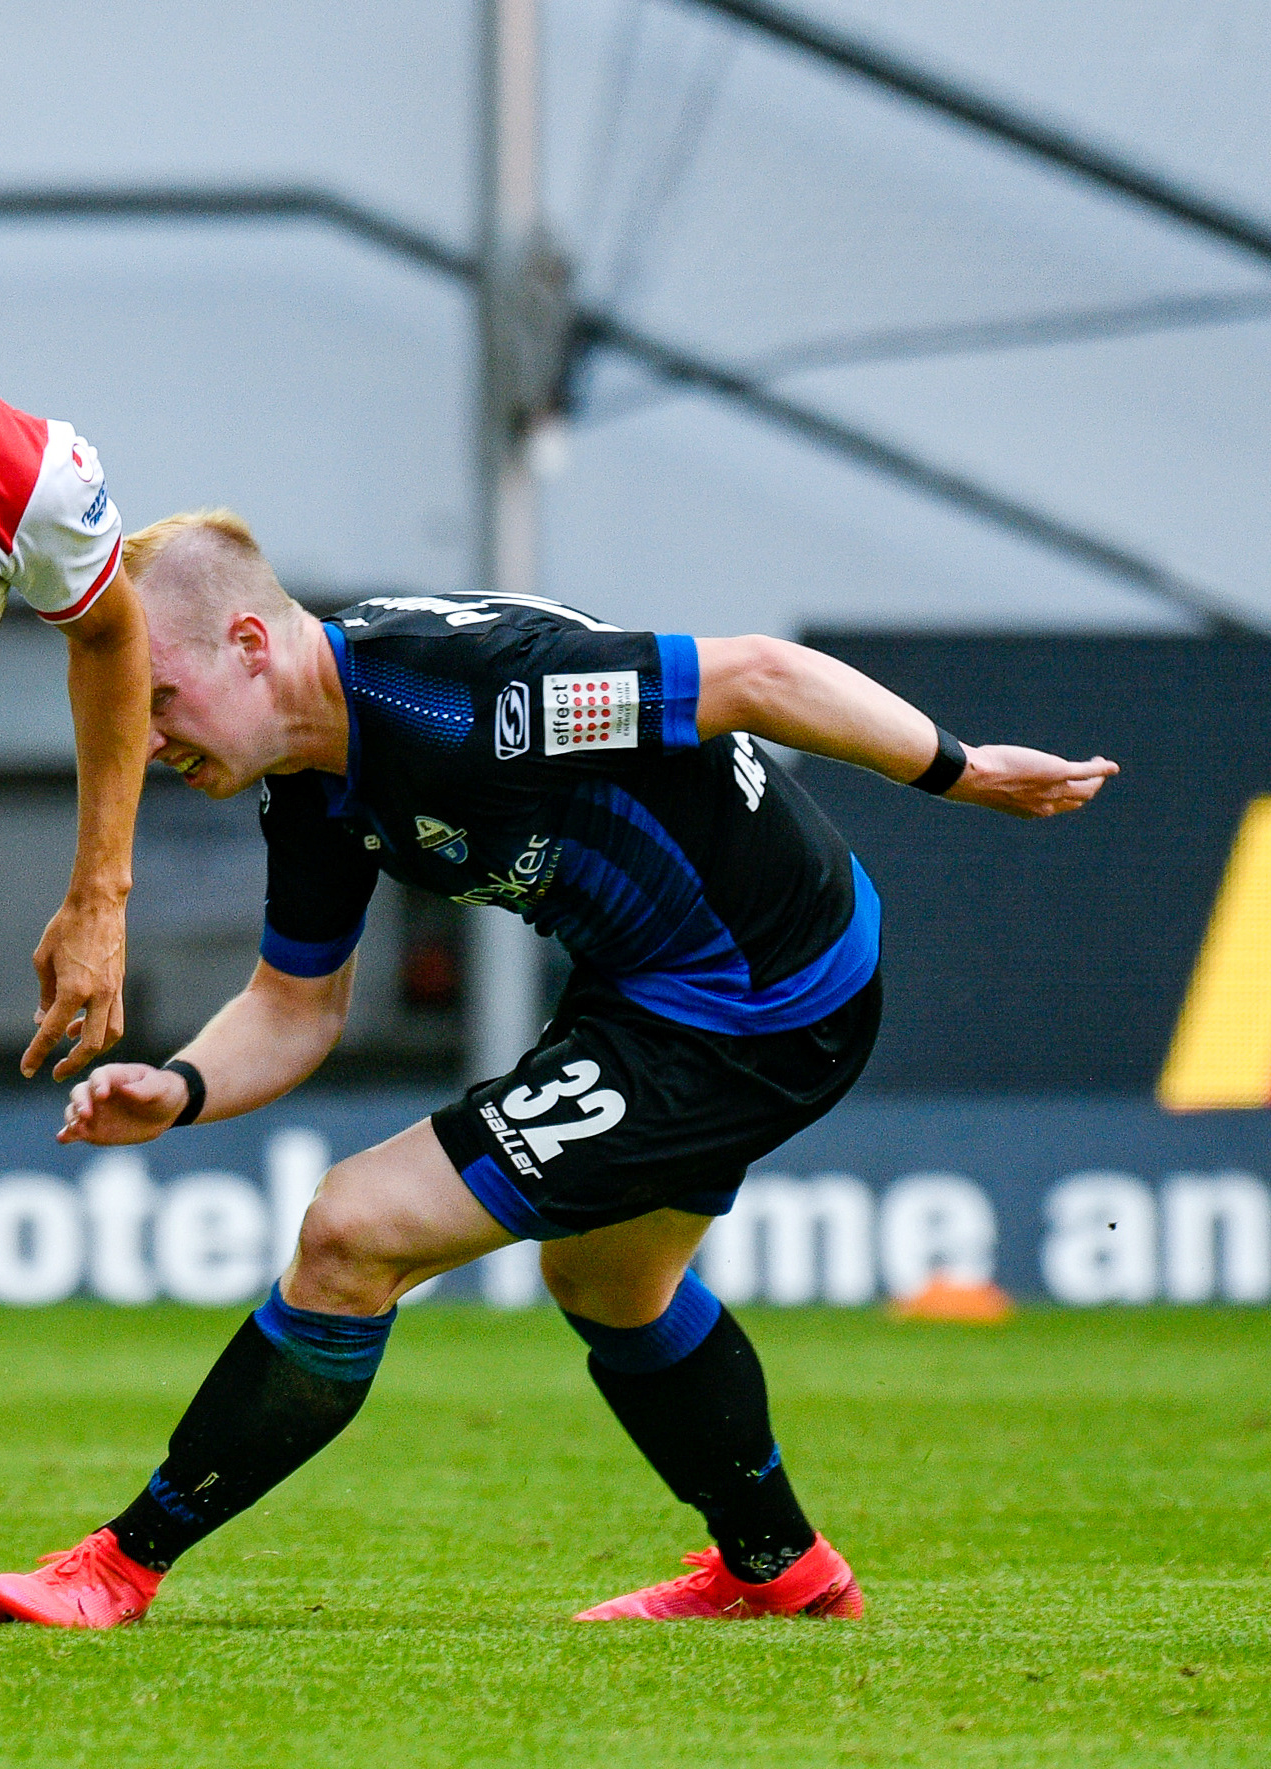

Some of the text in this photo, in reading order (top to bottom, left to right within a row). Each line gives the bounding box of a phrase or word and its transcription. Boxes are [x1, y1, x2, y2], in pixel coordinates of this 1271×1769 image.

[552, 684, 570, 746] effect
[502, 1059, 627, 1164] 32
[701, 1171, 999, 1306] me
